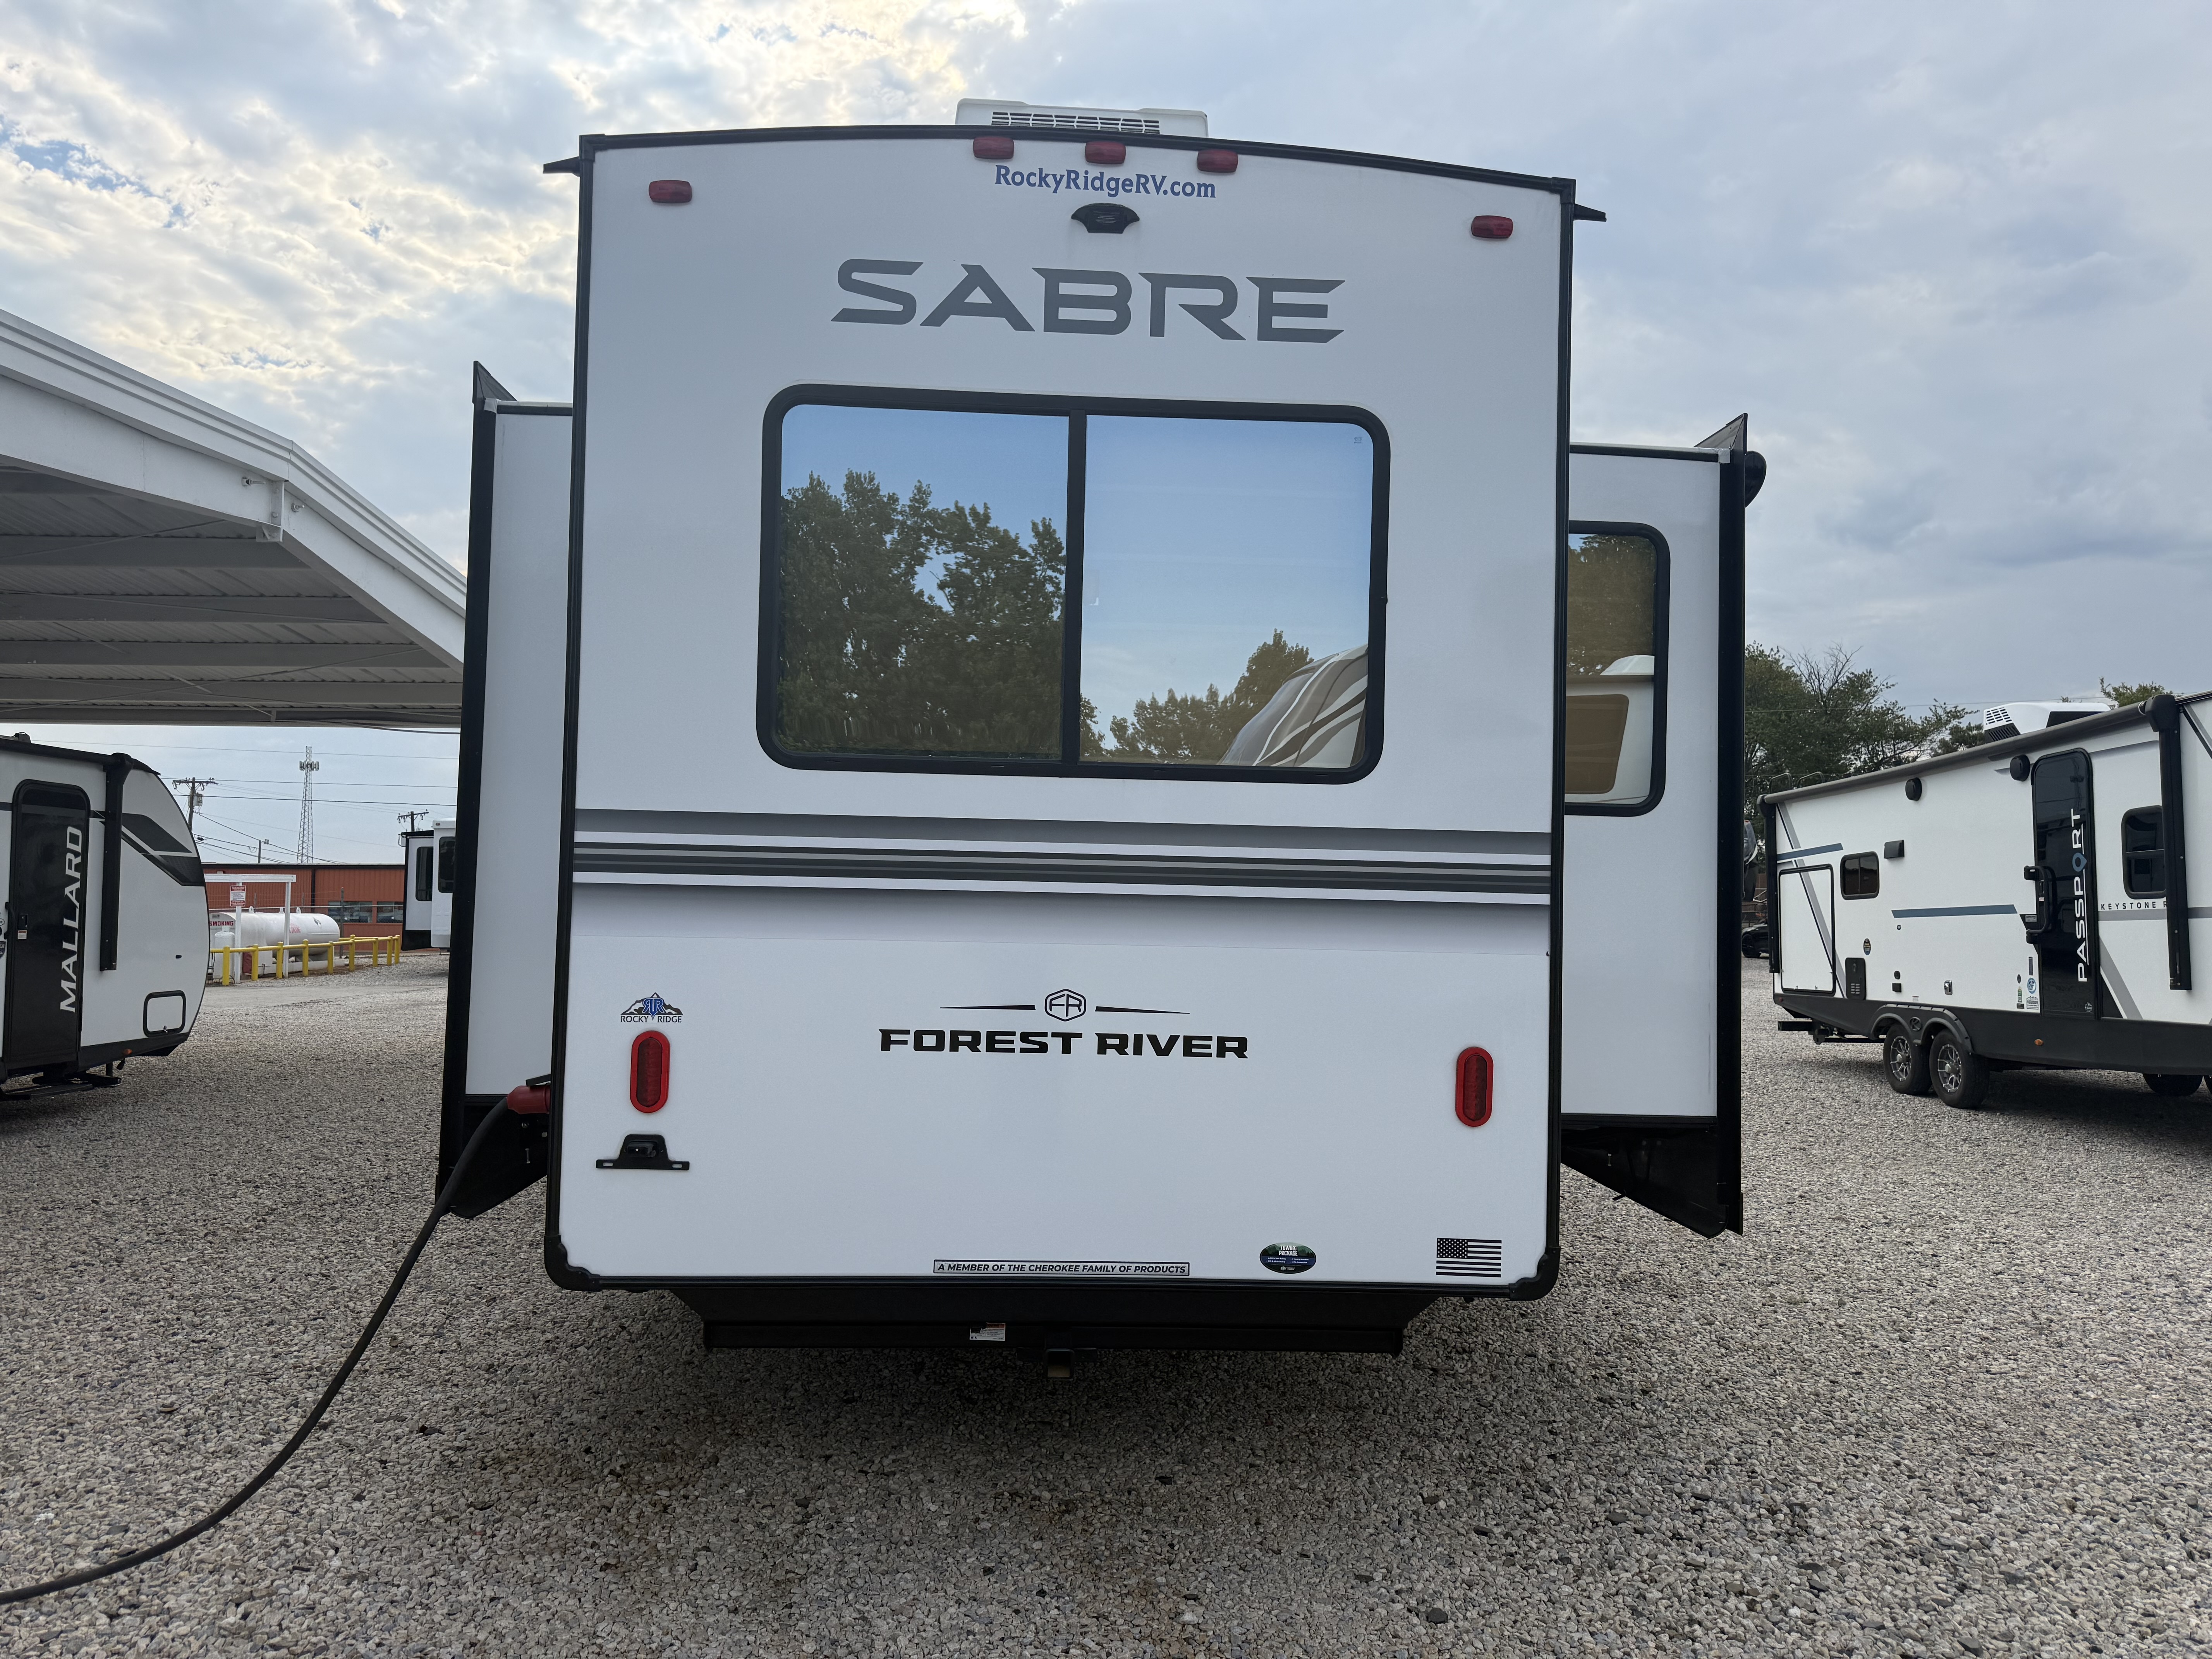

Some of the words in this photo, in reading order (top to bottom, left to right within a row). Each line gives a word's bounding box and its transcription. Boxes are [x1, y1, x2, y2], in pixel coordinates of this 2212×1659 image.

[994, 165, 1216, 198] RockyRidgeRV.com
[831, 258, 1346, 343] SABRE
[60, 826, 82, 1013] MALLARD
[2070, 808, 2088, 982] PASSPORT
[2101, 901, 2156, 910] KEYSTONE
[878, 1029, 1083, 1054] FOREST
[1095, 1033, 1248, 1059] RIVER
